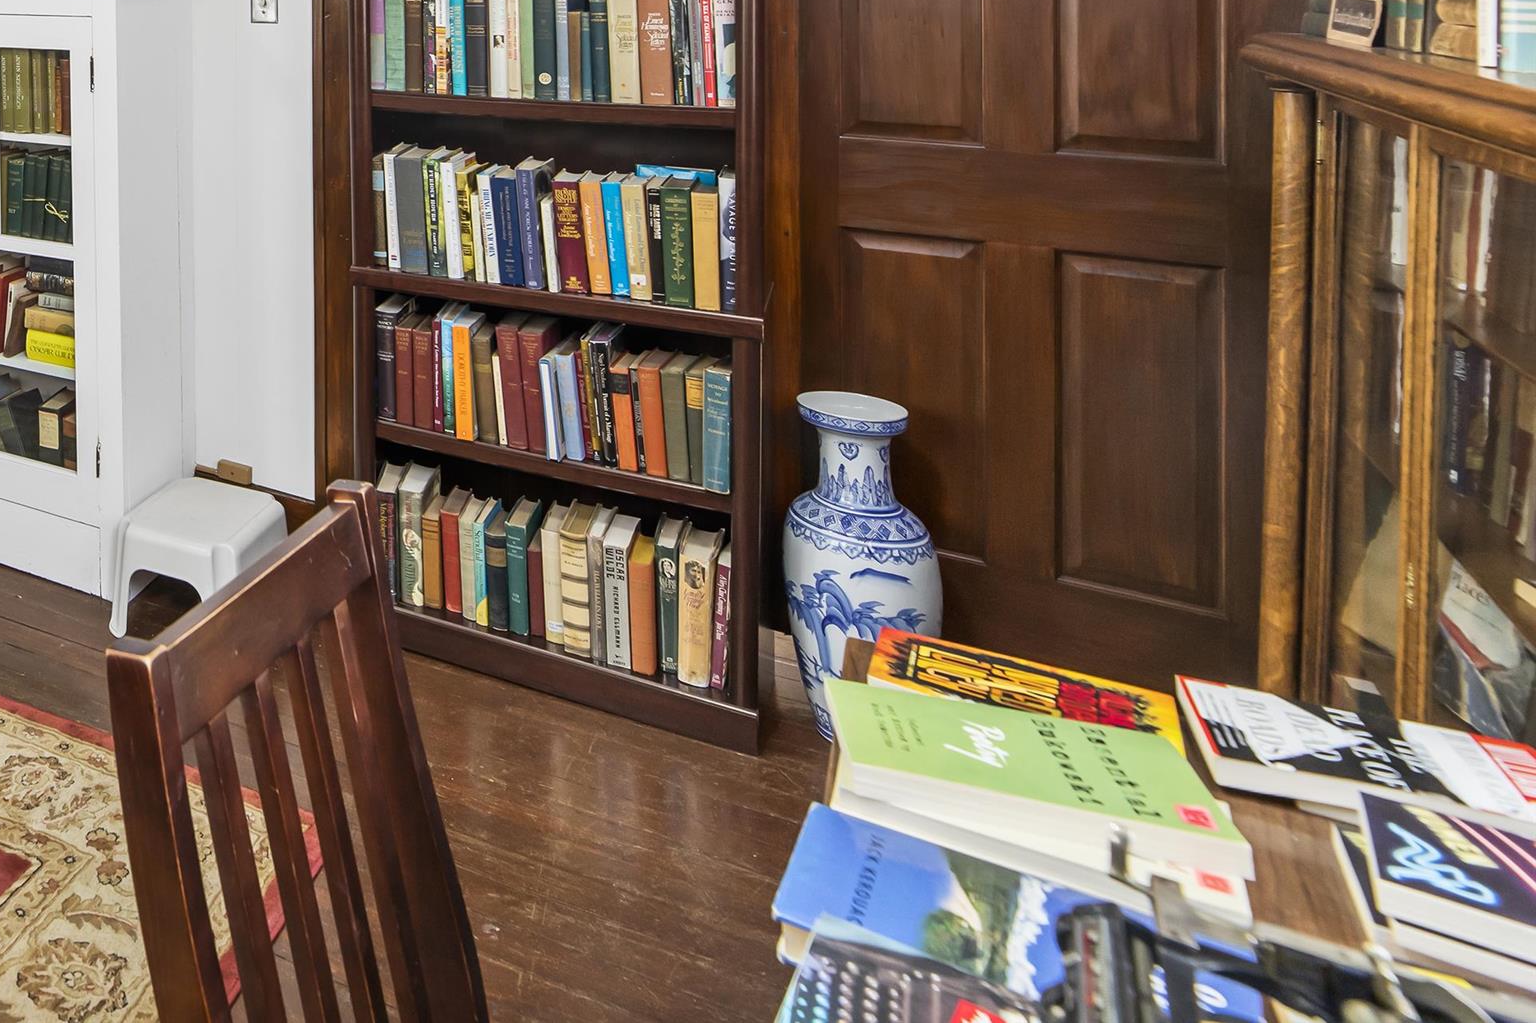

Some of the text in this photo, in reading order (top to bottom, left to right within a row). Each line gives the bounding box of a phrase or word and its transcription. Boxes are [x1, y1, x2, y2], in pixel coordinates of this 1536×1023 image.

[454, 6, 464, 73] ROBERT FROST
[728, 193, 736, 272] SAVAGE BEAUTY
[30, 347, 53, 356] OSCAR
[601, 393, 609, 411] Portrait
[605, 421, 613, 443] Marriage
[474, 530, 483, 561] Stendhal
[605, 548, 615, 579] WILDE
[615, 549, 625, 581] OSCAR
[943, 719, 1010, 769] Poetry
[1031, 718, 1104, 806] Bukowski
[1080, 725, 1163, 818] Essential
[1361, 760, 1413, 792] OF
[846, 834, 886, 926] JACK KEROUAC
